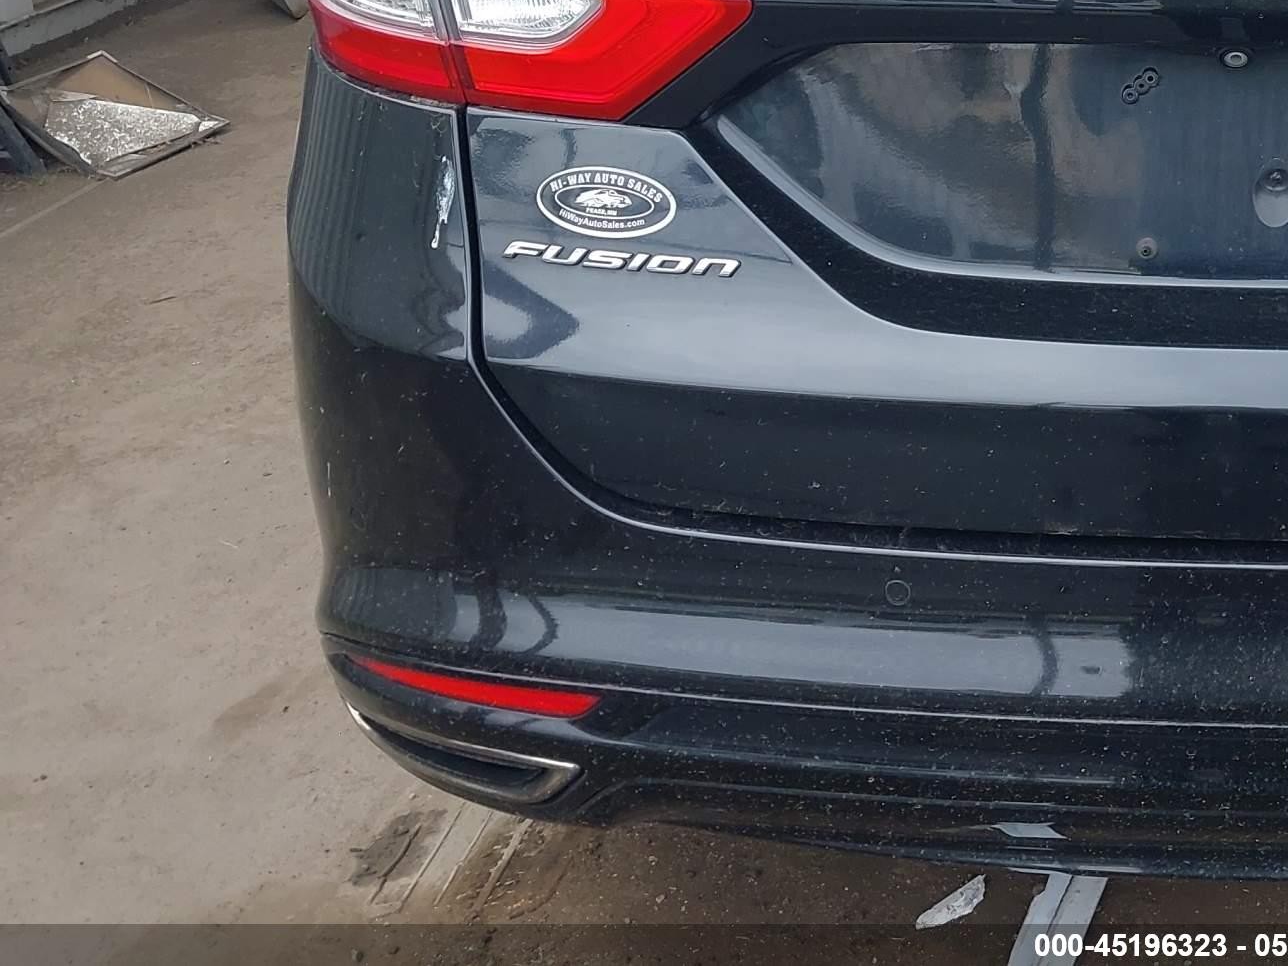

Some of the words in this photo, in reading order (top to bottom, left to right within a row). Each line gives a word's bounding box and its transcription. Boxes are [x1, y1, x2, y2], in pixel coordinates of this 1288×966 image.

[550, 172, 592, 192] HI-WAY
[594, 172, 625, 186] AUTO
[627, 178, 663, 203] SALES
[558, 208, 645, 229] HiWayAutoSales.com
[502, 241, 742, 277] FUSION
